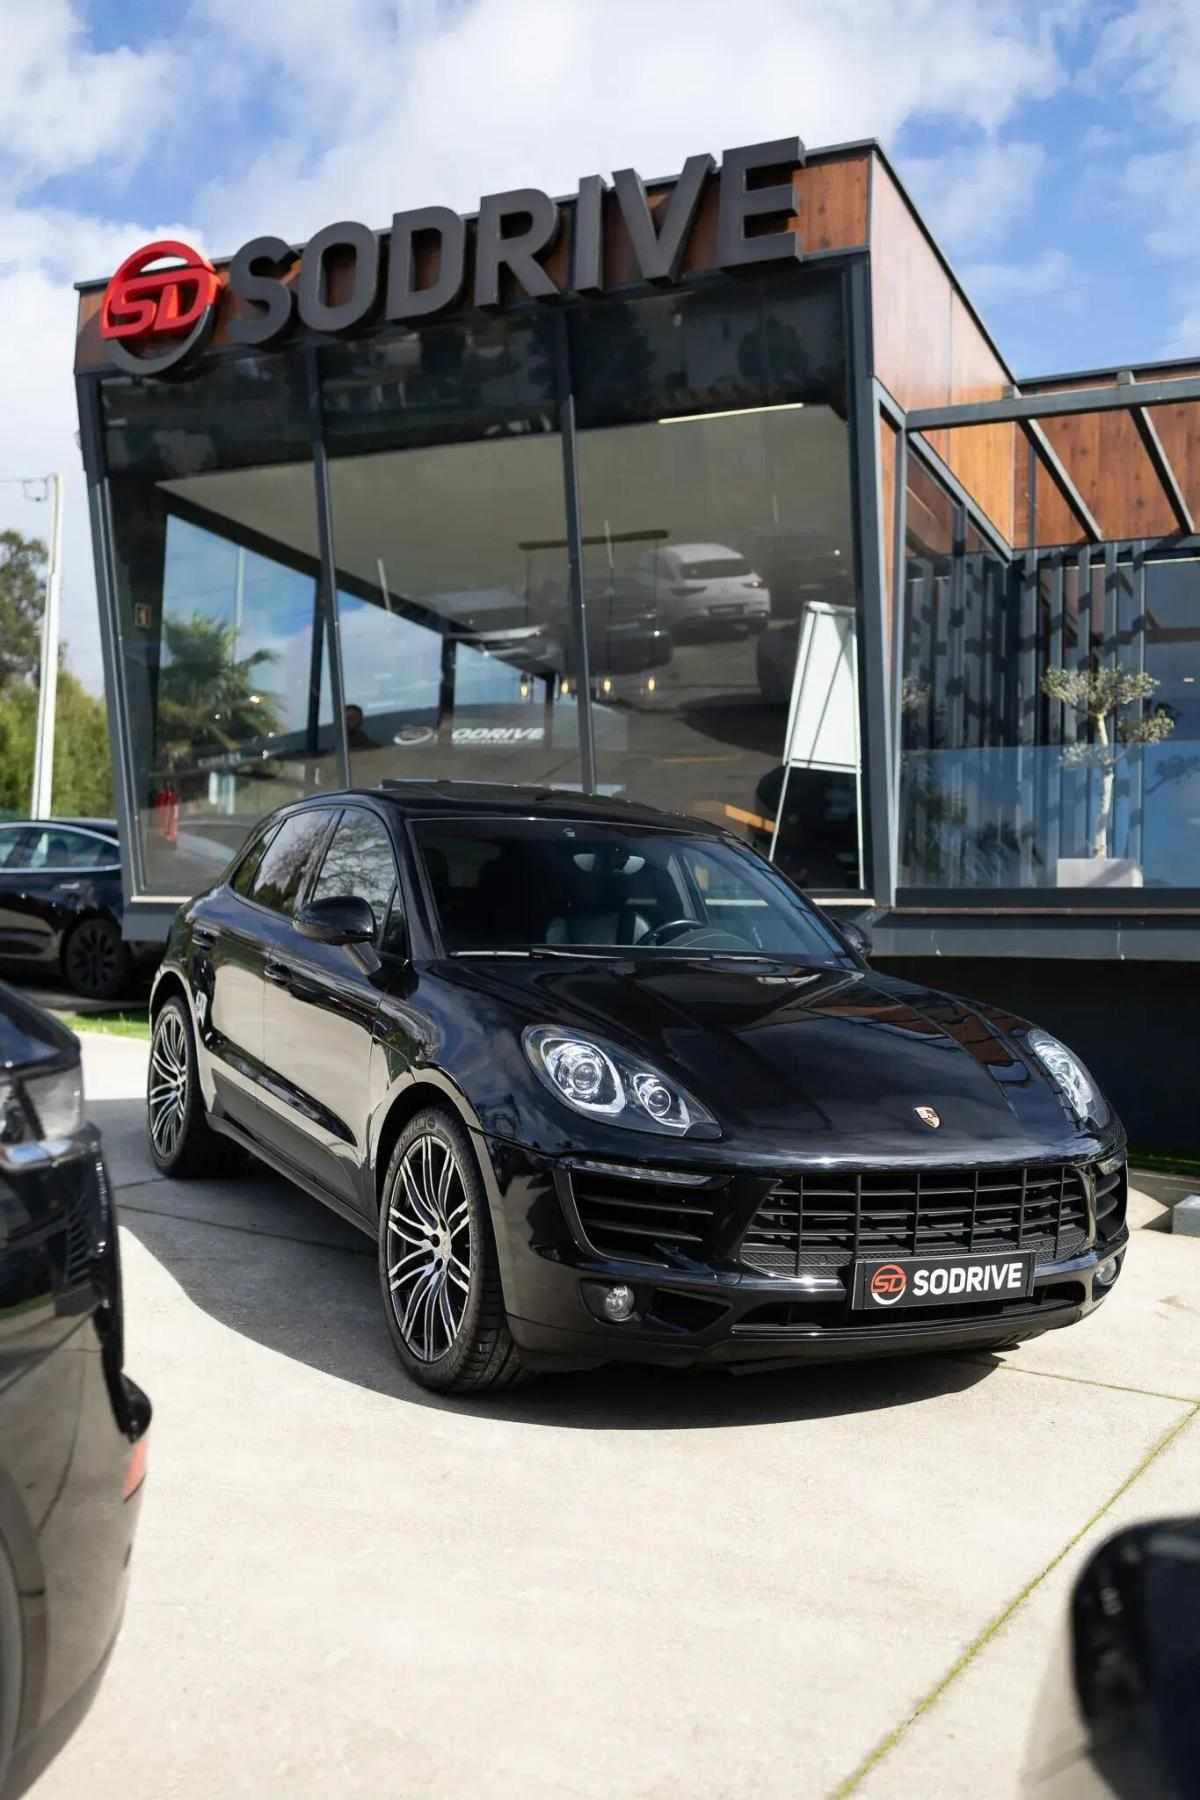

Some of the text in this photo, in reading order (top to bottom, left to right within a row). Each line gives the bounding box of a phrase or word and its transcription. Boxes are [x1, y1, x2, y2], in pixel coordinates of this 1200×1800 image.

[101, 136, 804, 345] SD SODRIVE
[433, 727, 545, 741] ODRIVE
[912, 1262, 1024, 1297] SODRIVE
